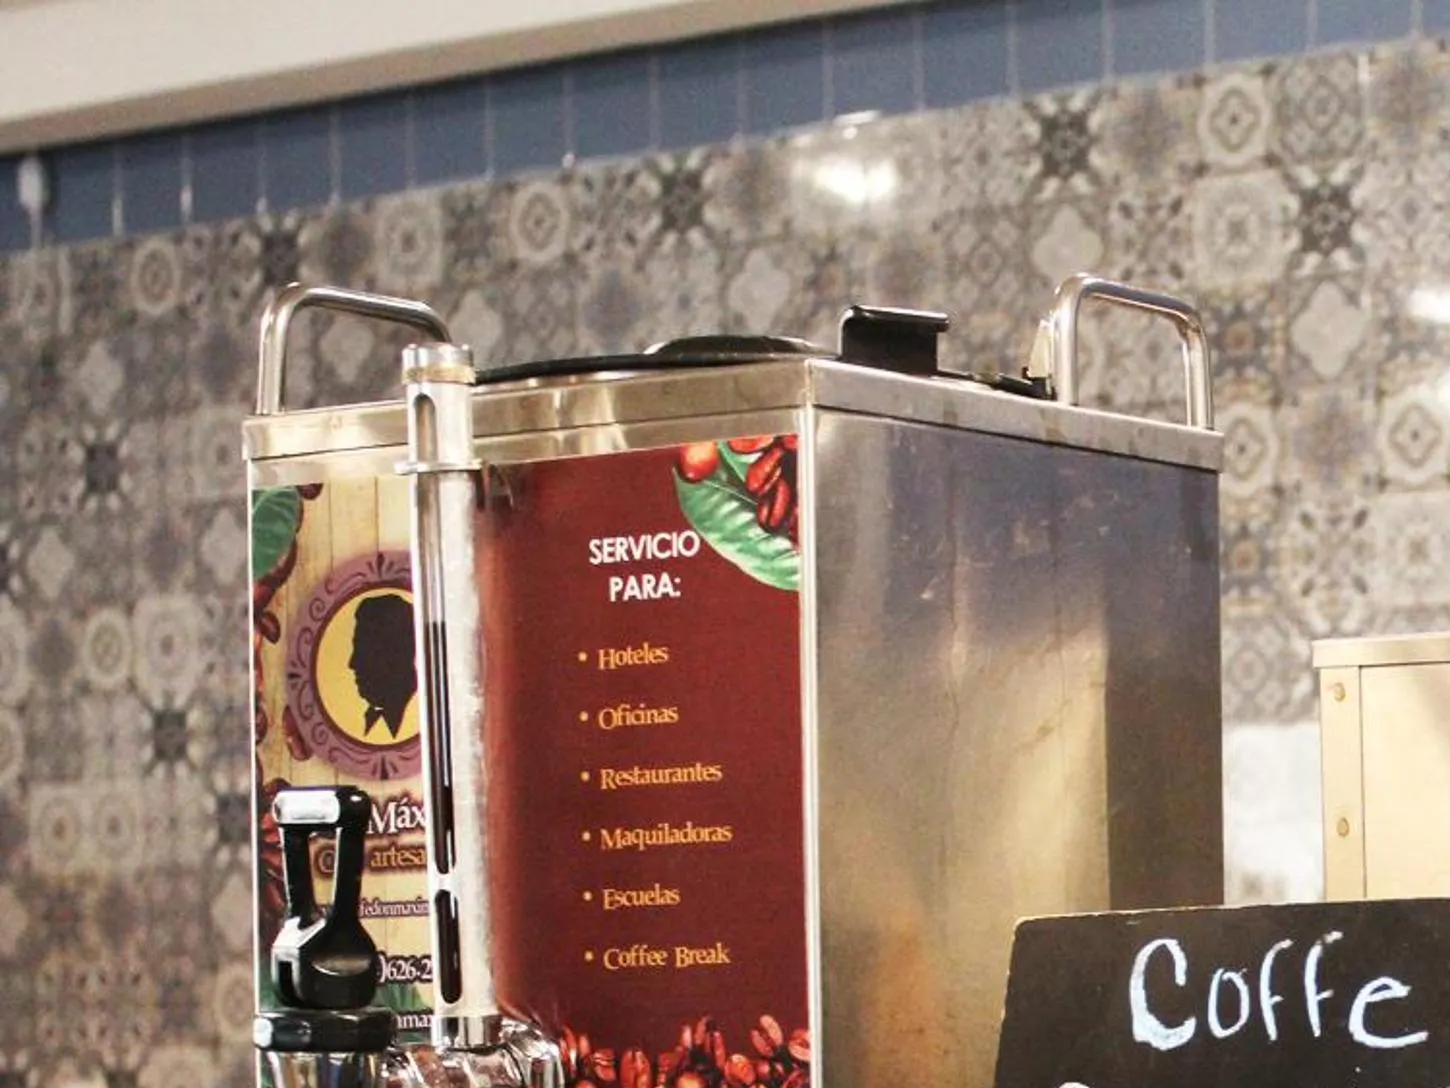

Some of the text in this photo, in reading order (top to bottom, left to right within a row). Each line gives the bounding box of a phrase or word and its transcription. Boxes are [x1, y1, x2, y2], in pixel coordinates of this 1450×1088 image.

[589, 530, 700, 565] SERVICIO
[609, 572, 682, 602] PARA:
[598, 642, 670, 670] Hoteles
[598, 703, 680, 730] Oficinas
[600, 763, 723, 790] Restaurantes
[367, 796, 427, 835] Máx
[600, 821, 733, 851] Maquiladoras
[370, 846, 427, 868] artesa
[602, 883, 681, 910] Escuelas
[603, 942, 731, 971] Coffee Break
